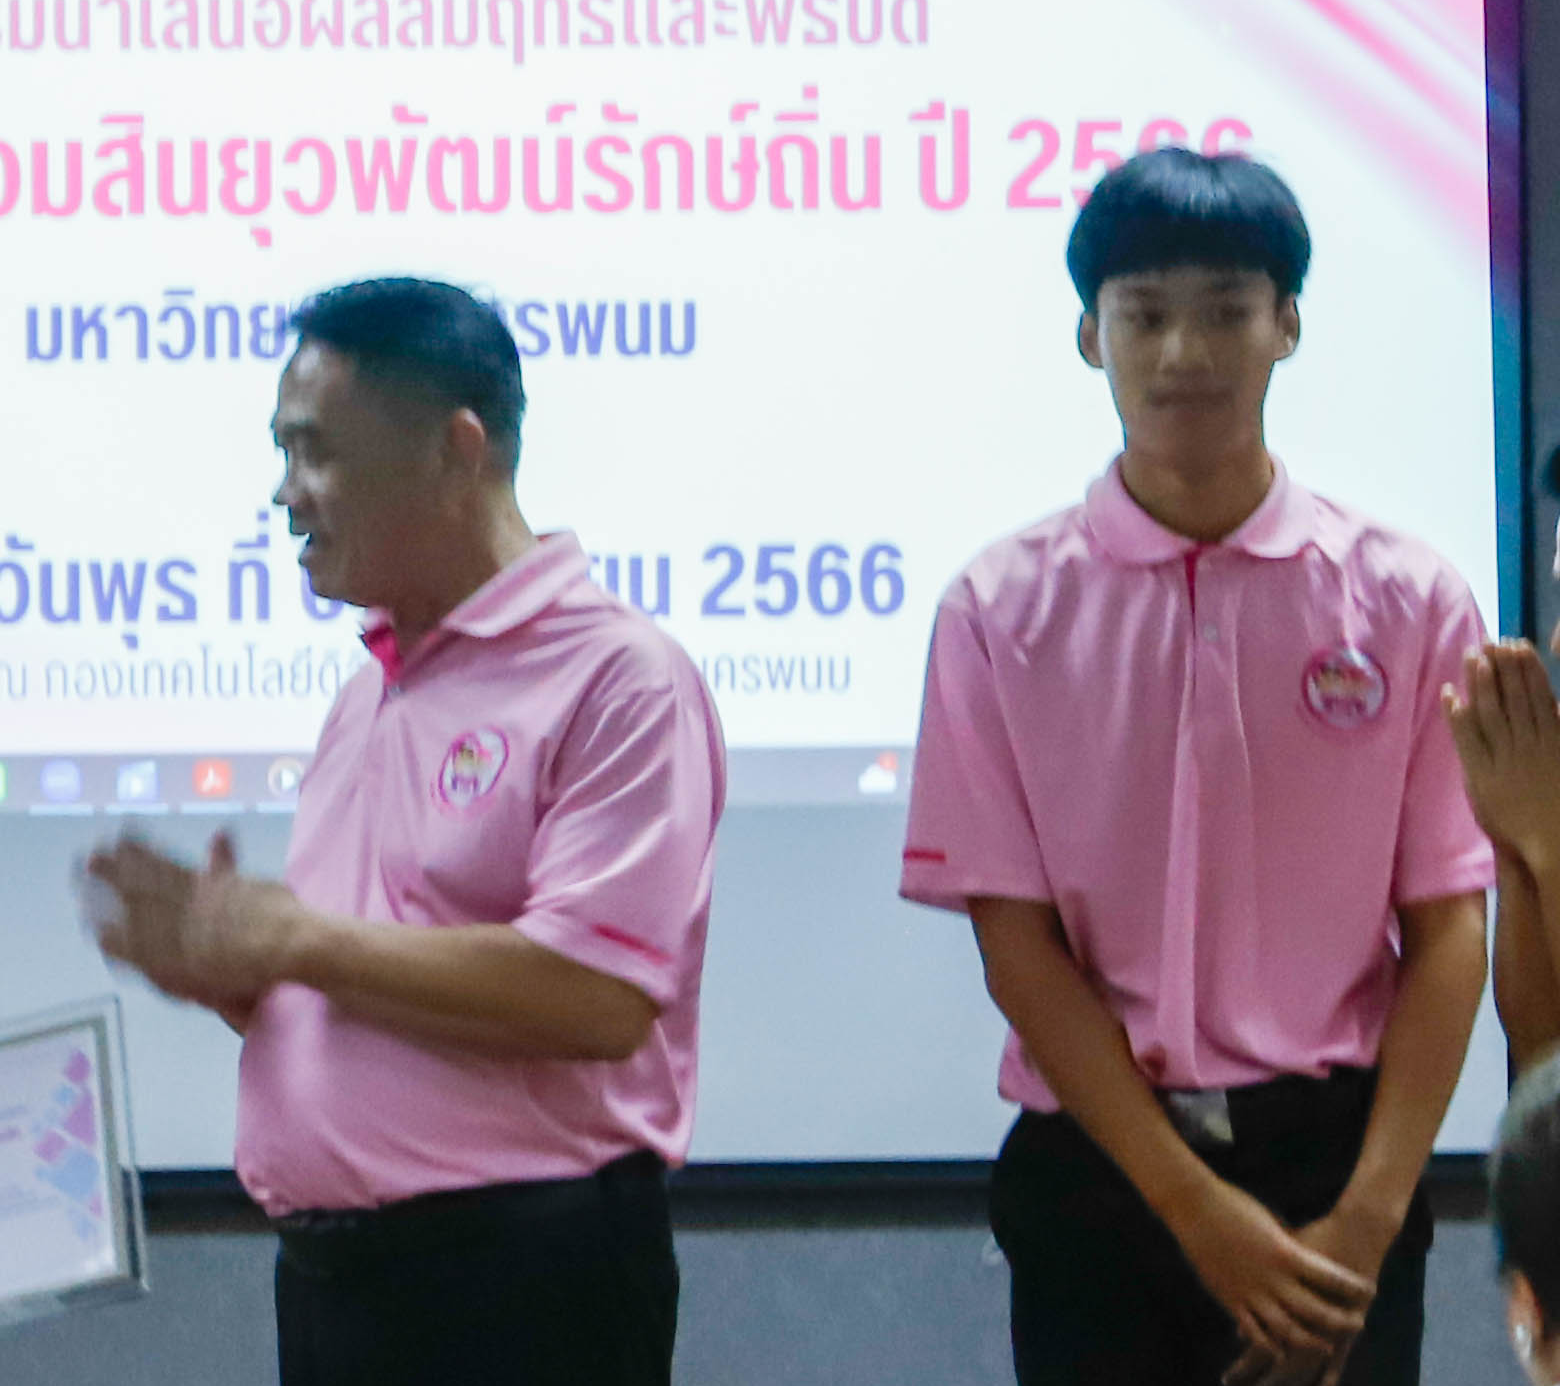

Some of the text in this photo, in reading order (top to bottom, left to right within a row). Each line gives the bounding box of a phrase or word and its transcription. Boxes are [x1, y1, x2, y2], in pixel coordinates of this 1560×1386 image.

[907, 100, 971, 213] ปี
[226, 510, 270, 622] ที่
[700, 543, 905, 618] 2566
